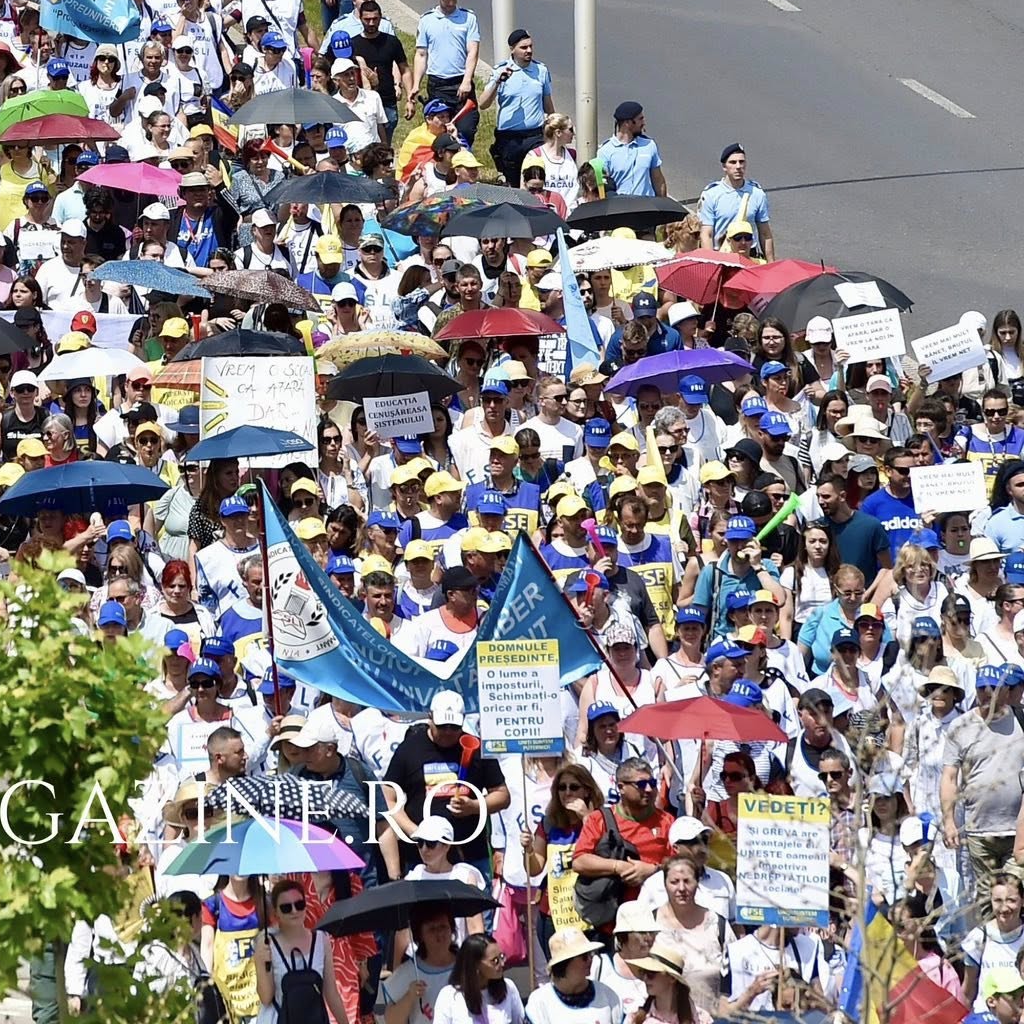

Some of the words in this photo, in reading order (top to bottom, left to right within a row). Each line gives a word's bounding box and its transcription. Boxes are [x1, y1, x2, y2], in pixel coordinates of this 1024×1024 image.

[373, 415, 426, 429] SISTEMULUI
[488, 643, 548, 652] DOMNULE
[479, 653, 558, 667] PREȘEDINTE,
[486, 670, 496, 679] O
[499, 670, 528, 678] lume
[482, 680, 544, 692] imposturii,
[488, 691, 558, 702] Schimbați-o
[482, 703, 513, 713] orice
[516, 704, 528, 712] ar
[531, 702, 543, 713] fi,
[495, 715, 545, 727] PENTRU
[503, 727, 542, 738] COPII!
[763, 827, 798, 837] GREVA
[748, 839, 802, 849] avantajele
